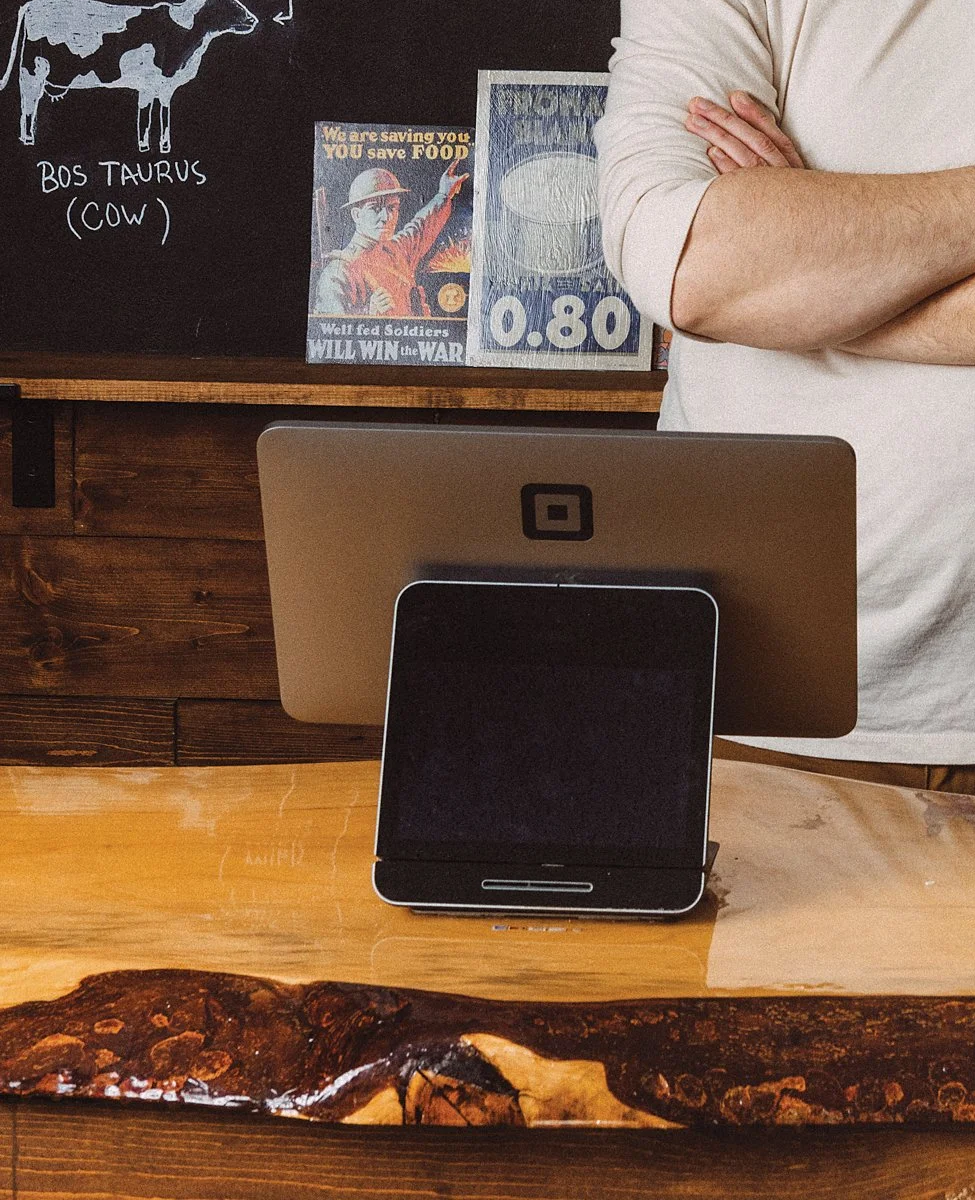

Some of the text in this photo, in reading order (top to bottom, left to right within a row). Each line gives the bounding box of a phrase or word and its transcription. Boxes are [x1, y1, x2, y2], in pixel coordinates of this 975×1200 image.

[322, 126, 470, 144] We are saving you
[322, 143, 469, 160] YOU save FOOD
[37, 160, 206, 193] BOS TAURUS
[319, 322, 449, 338] Well fed Soldiers
[489, 294, 631, 350] 0.80
[307, 339, 464, 362] WILL WIN the WAR
